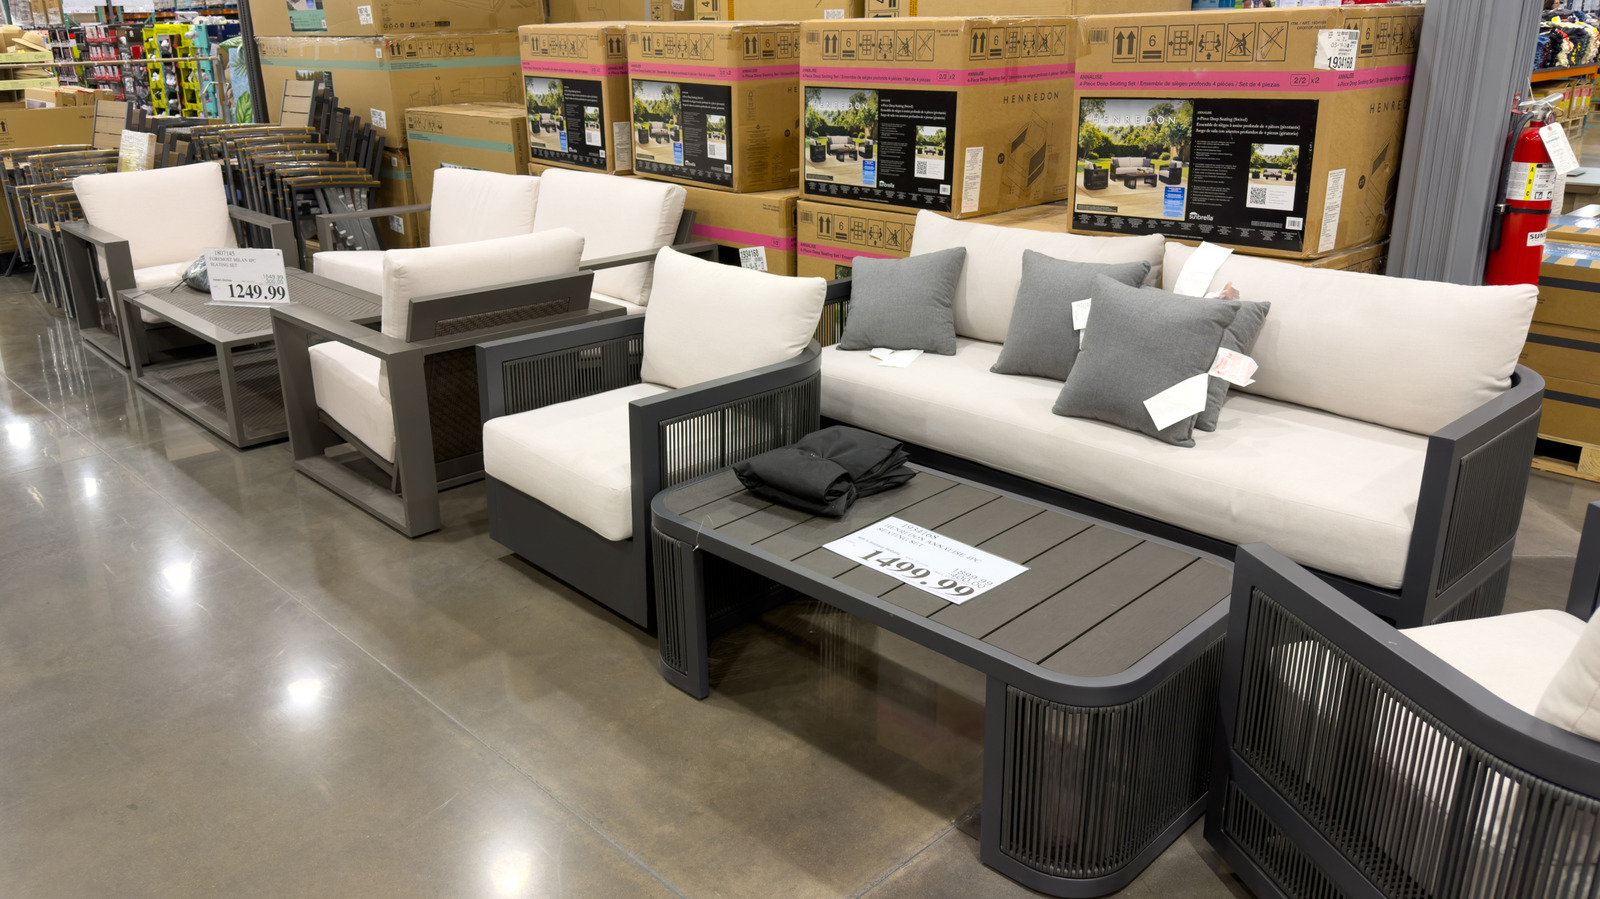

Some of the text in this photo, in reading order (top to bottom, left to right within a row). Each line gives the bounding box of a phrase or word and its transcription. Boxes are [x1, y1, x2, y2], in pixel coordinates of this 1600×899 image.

[993, 35, 999, 46] 6
[1148, 34, 1157, 47] 6
[1365, 27, 1371, 41] 6
[765, 39, 770, 48] 6
[846, 37, 852, 48] 6
[1327, 56, 1353, 69] 1934168
[1293, 76, 1307, 84] 2/2
[1003, 91, 1060, 104] HENREDON
[1369, 98, 1409, 114] HENRED
[1092, 113, 1176, 126] HENREDON
[838, 221, 844, 231] 6
[227, 283, 287, 300] 1249.99
[858, 549, 975, 596] 1499.99
[952, 567, 994, 586] 1899.99
